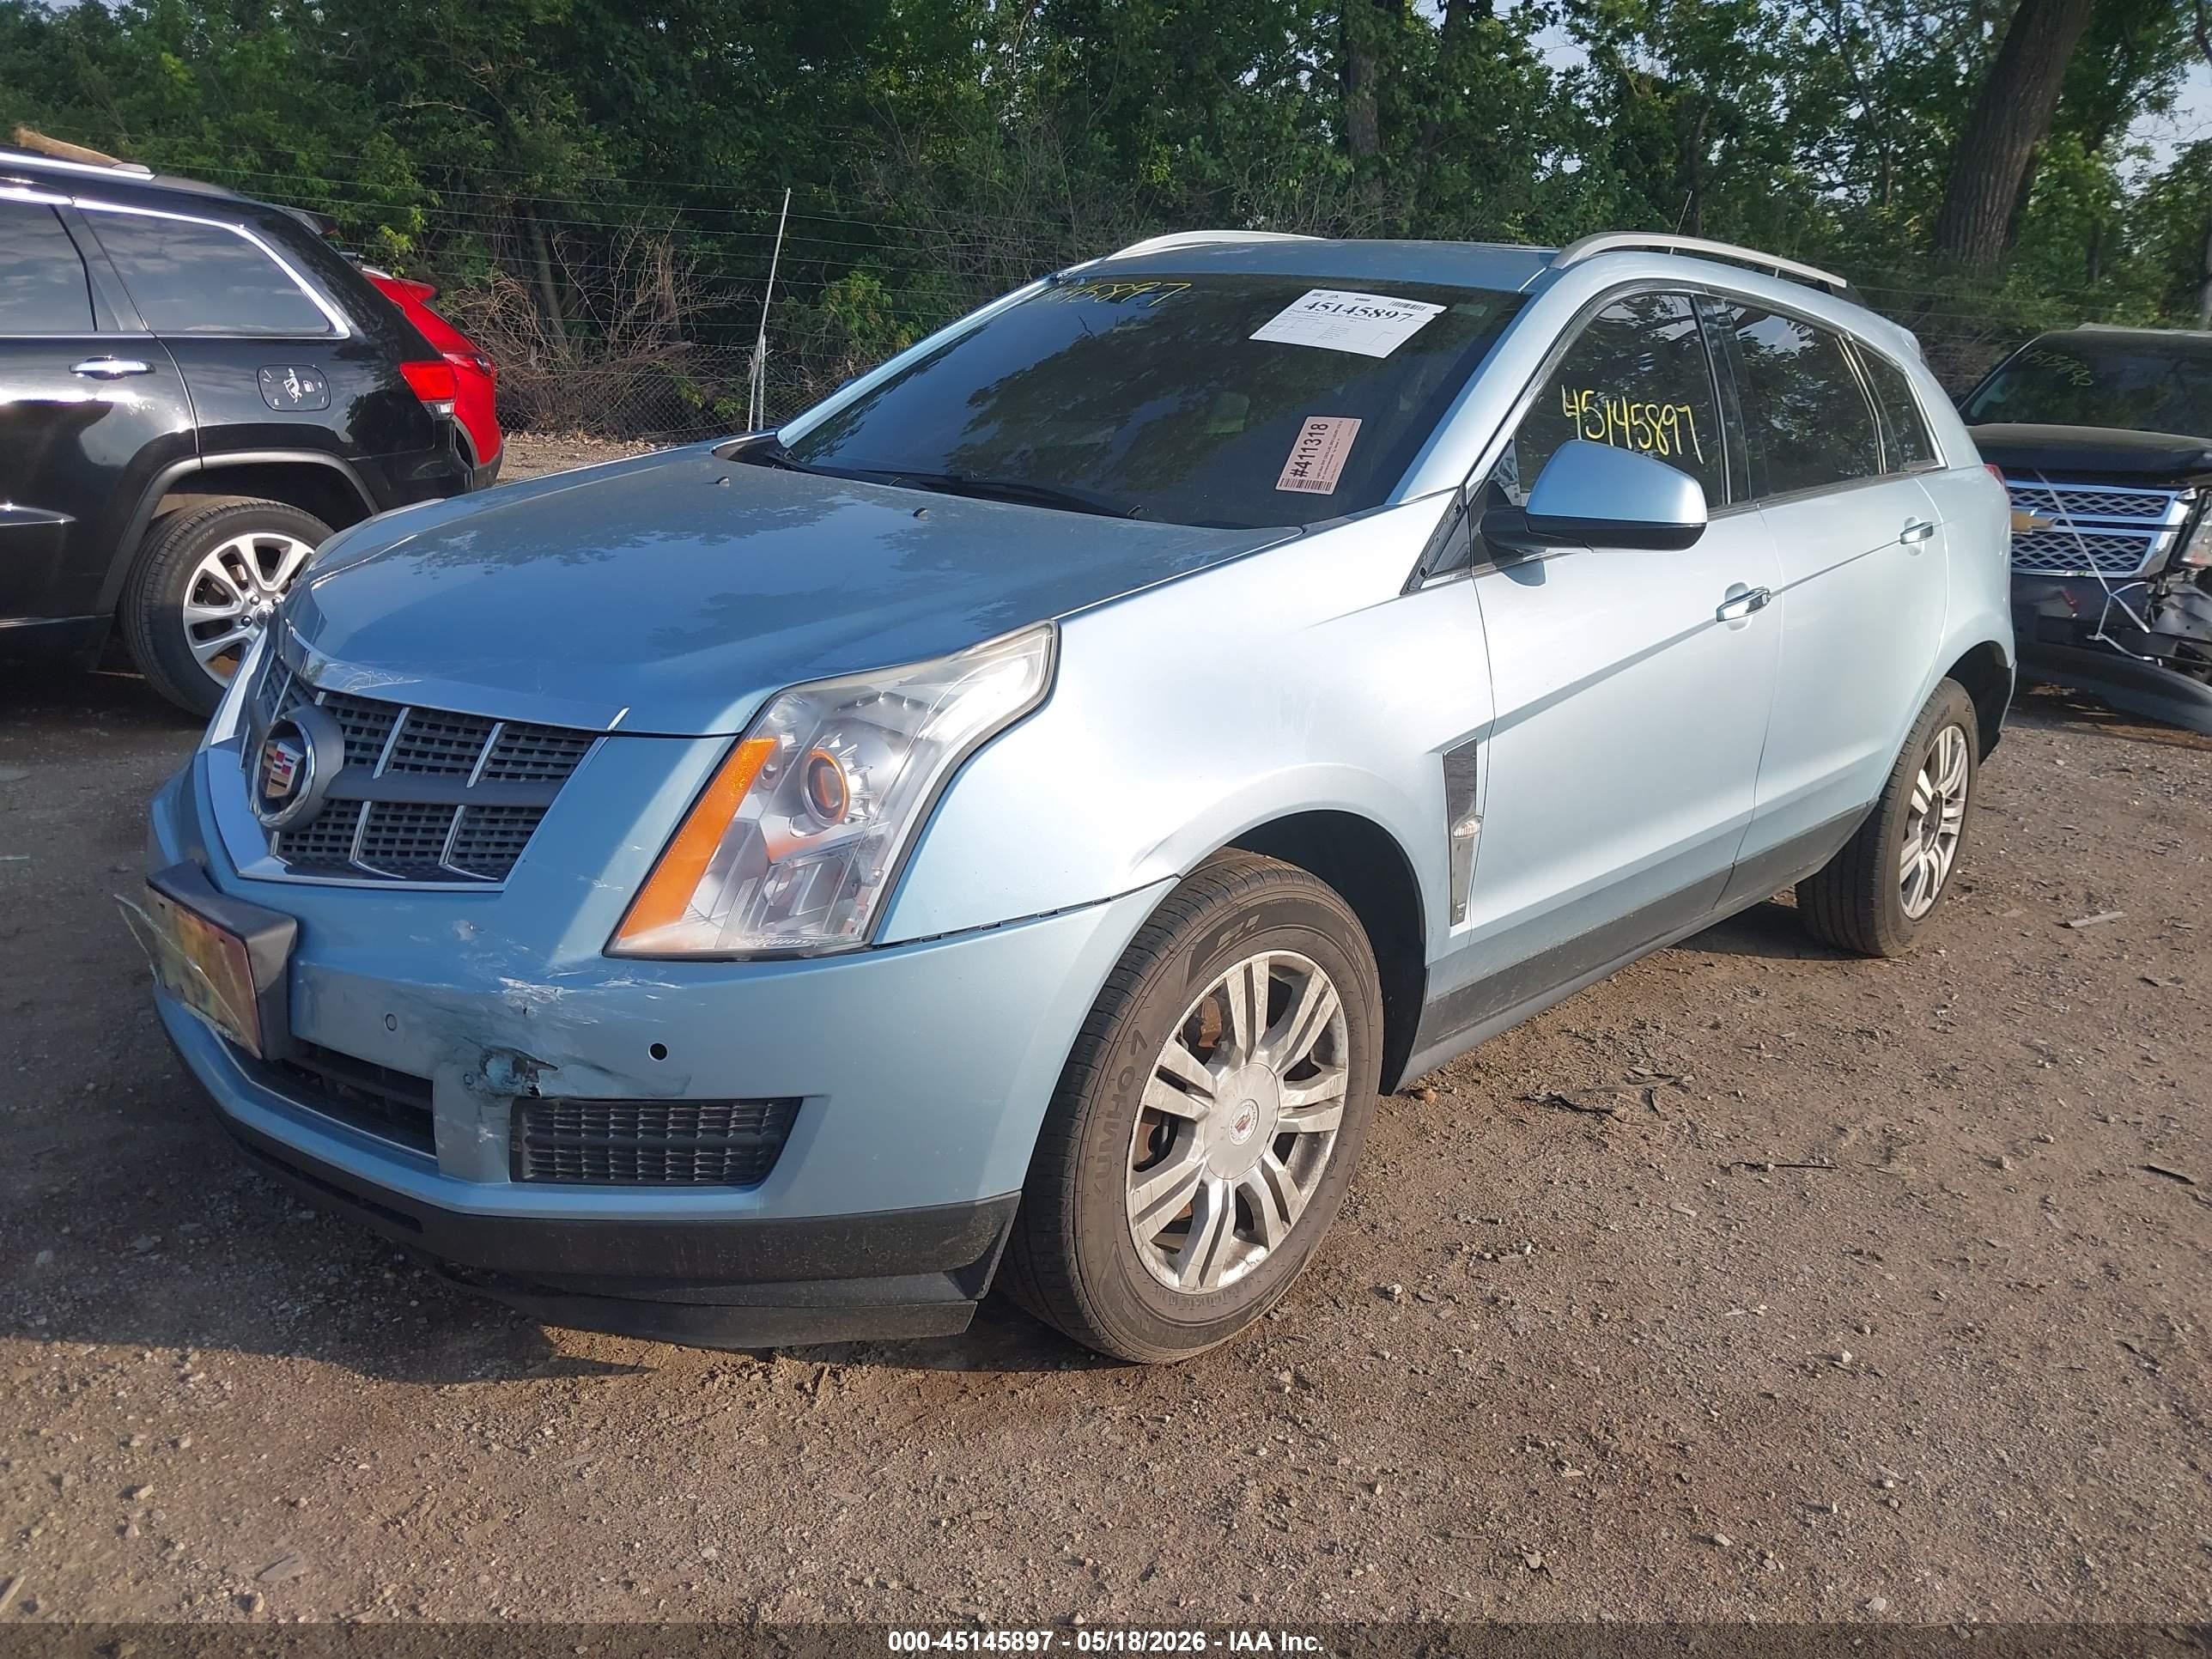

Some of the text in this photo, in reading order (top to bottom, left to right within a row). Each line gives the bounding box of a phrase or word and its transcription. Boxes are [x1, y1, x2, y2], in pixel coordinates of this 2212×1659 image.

[1304, 301, 1415, 323] 45145897
[1289, 422, 1329, 477] #411318
[1561, 385, 1704, 465] 45145897
